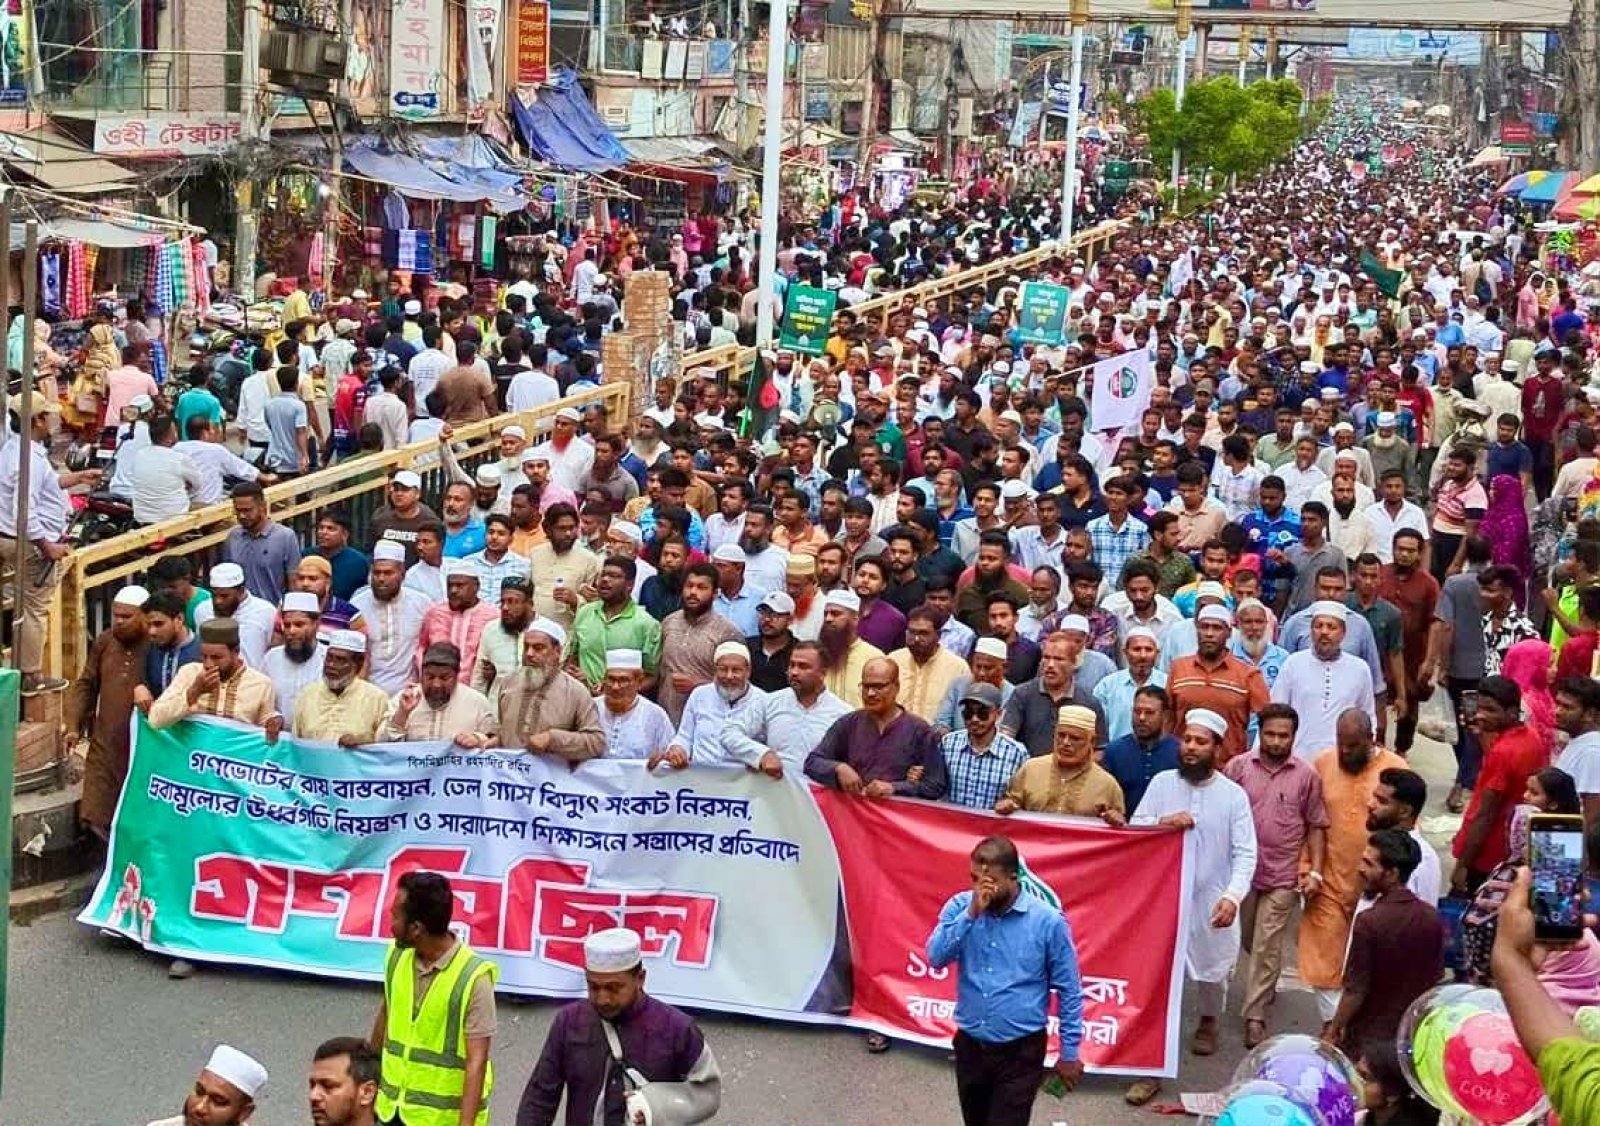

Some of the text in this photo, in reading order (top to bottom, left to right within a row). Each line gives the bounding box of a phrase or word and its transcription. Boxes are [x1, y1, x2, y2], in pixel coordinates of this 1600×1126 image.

[103, 122, 146, 147] ওহী
[191, 752, 296, 790] গণভোটের
[300, 777, 329, 797] রায়
[443, 777, 482, 798] তেল
[488, 781, 535, 804] গ্যাস
[540, 781, 599, 819] বিদ্যুৎ
[605, 790, 671, 816] সংকট
[676, 788, 752, 821] নিরসন,
[335, 808, 408, 836] নিয়ন্ত্রণ
[414, 812, 431, 831] ও
[438, 813, 528, 839] সারাদেশে
[532, 816, 628, 851] শিক্ষাঙ্গনে
[632, 831, 715, 855] সন্ত্রাসের
[718, 829, 800, 865] প্রতিবাদে
